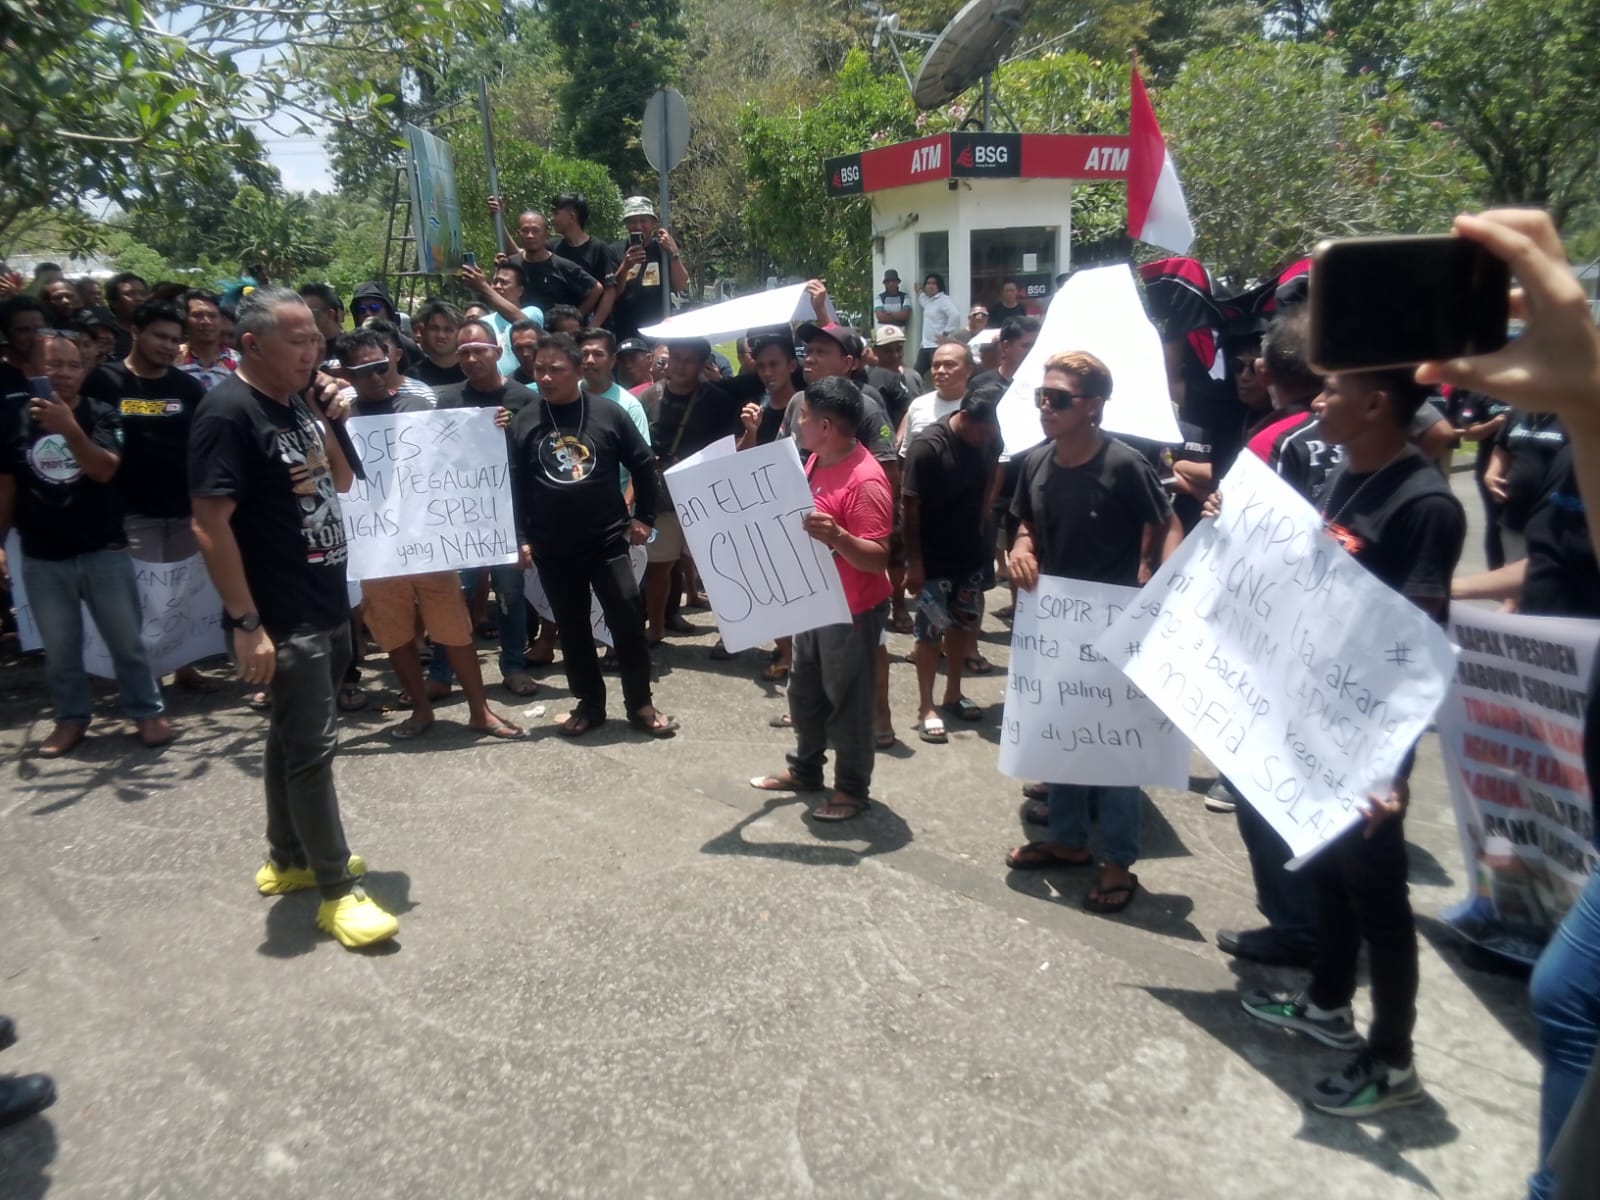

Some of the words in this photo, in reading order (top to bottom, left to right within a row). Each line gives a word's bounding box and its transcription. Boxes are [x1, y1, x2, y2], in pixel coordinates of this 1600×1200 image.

[911, 143, 942, 174] ATM
[974, 146, 1008, 163] BSG
[1084, 147, 1130, 171] ATM
[841, 165, 860, 182] BSG
[1027, 285, 1046, 295] BSG
[707, 463, 778, 514] ELIT
[425, 496, 498, 527] SPBU
[396, 541, 435, 566] yang
[709, 505, 829, 623] SULIT
[1036, 594, 1094, 624] SOPIR
[1058, 680, 1113, 708] paling
